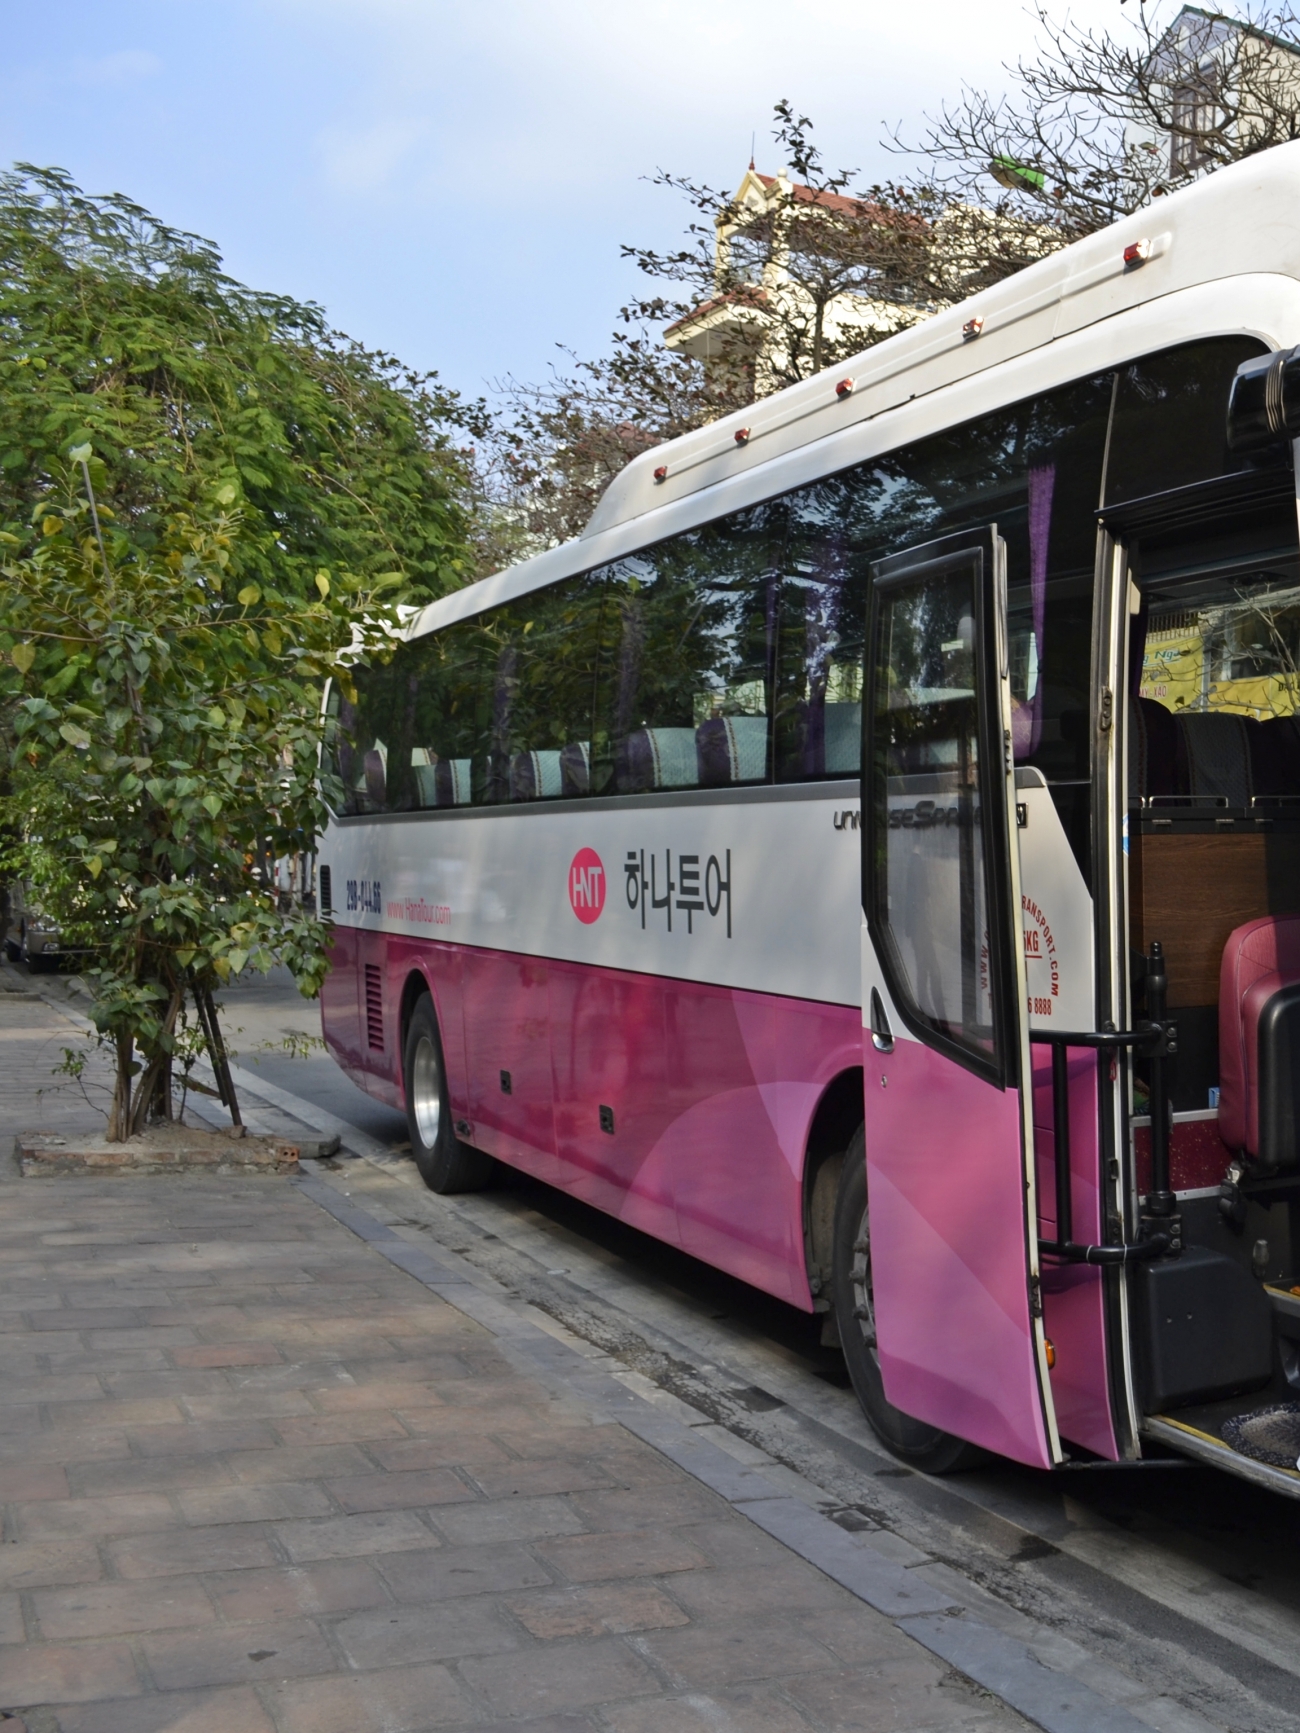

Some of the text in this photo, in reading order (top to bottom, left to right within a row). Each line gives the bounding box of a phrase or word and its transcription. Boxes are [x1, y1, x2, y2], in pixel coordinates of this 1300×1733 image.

[572, 866, 602, 908] HNT
[624, 849, 732, 939] 하나투어
[1021, 895, 1060, 997] RANSPORT.COM
[1034, 998, 1052, 1015] 8888
